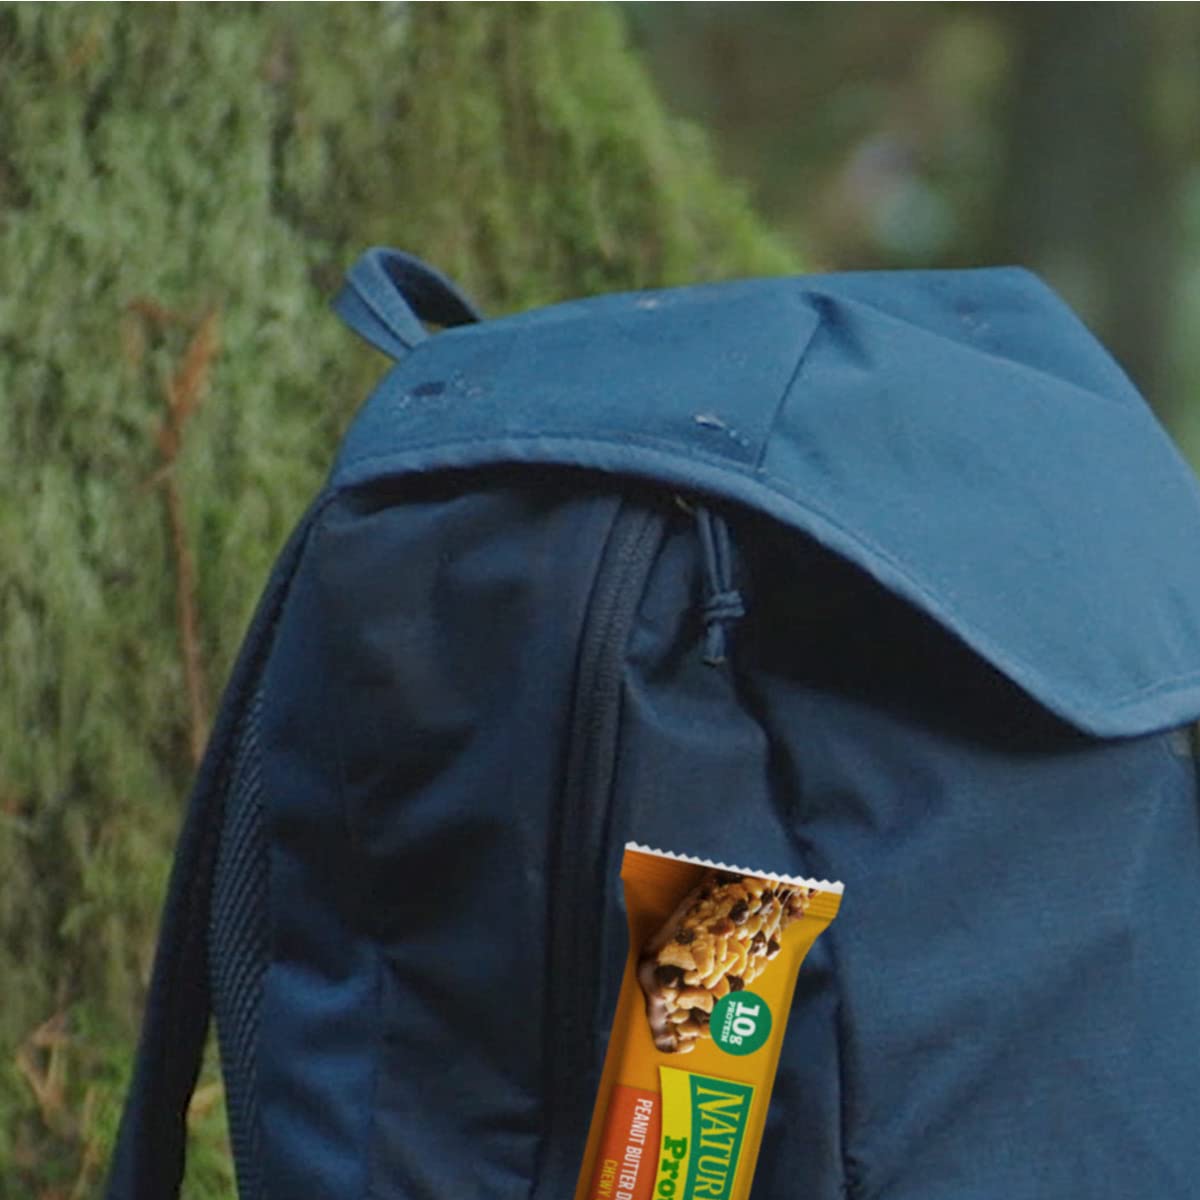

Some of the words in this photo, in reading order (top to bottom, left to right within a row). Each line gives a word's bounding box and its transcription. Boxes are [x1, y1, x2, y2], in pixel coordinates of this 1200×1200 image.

[720, 1000, 737, 1043] PROTEIN
[729, 1001, 760, 1047] 10g
[628, 1098, 653, 1146] PEANUT
[598, 1159, 618, 1199] CHEWY
[618, 1145, 643, 1191] BUTTER
